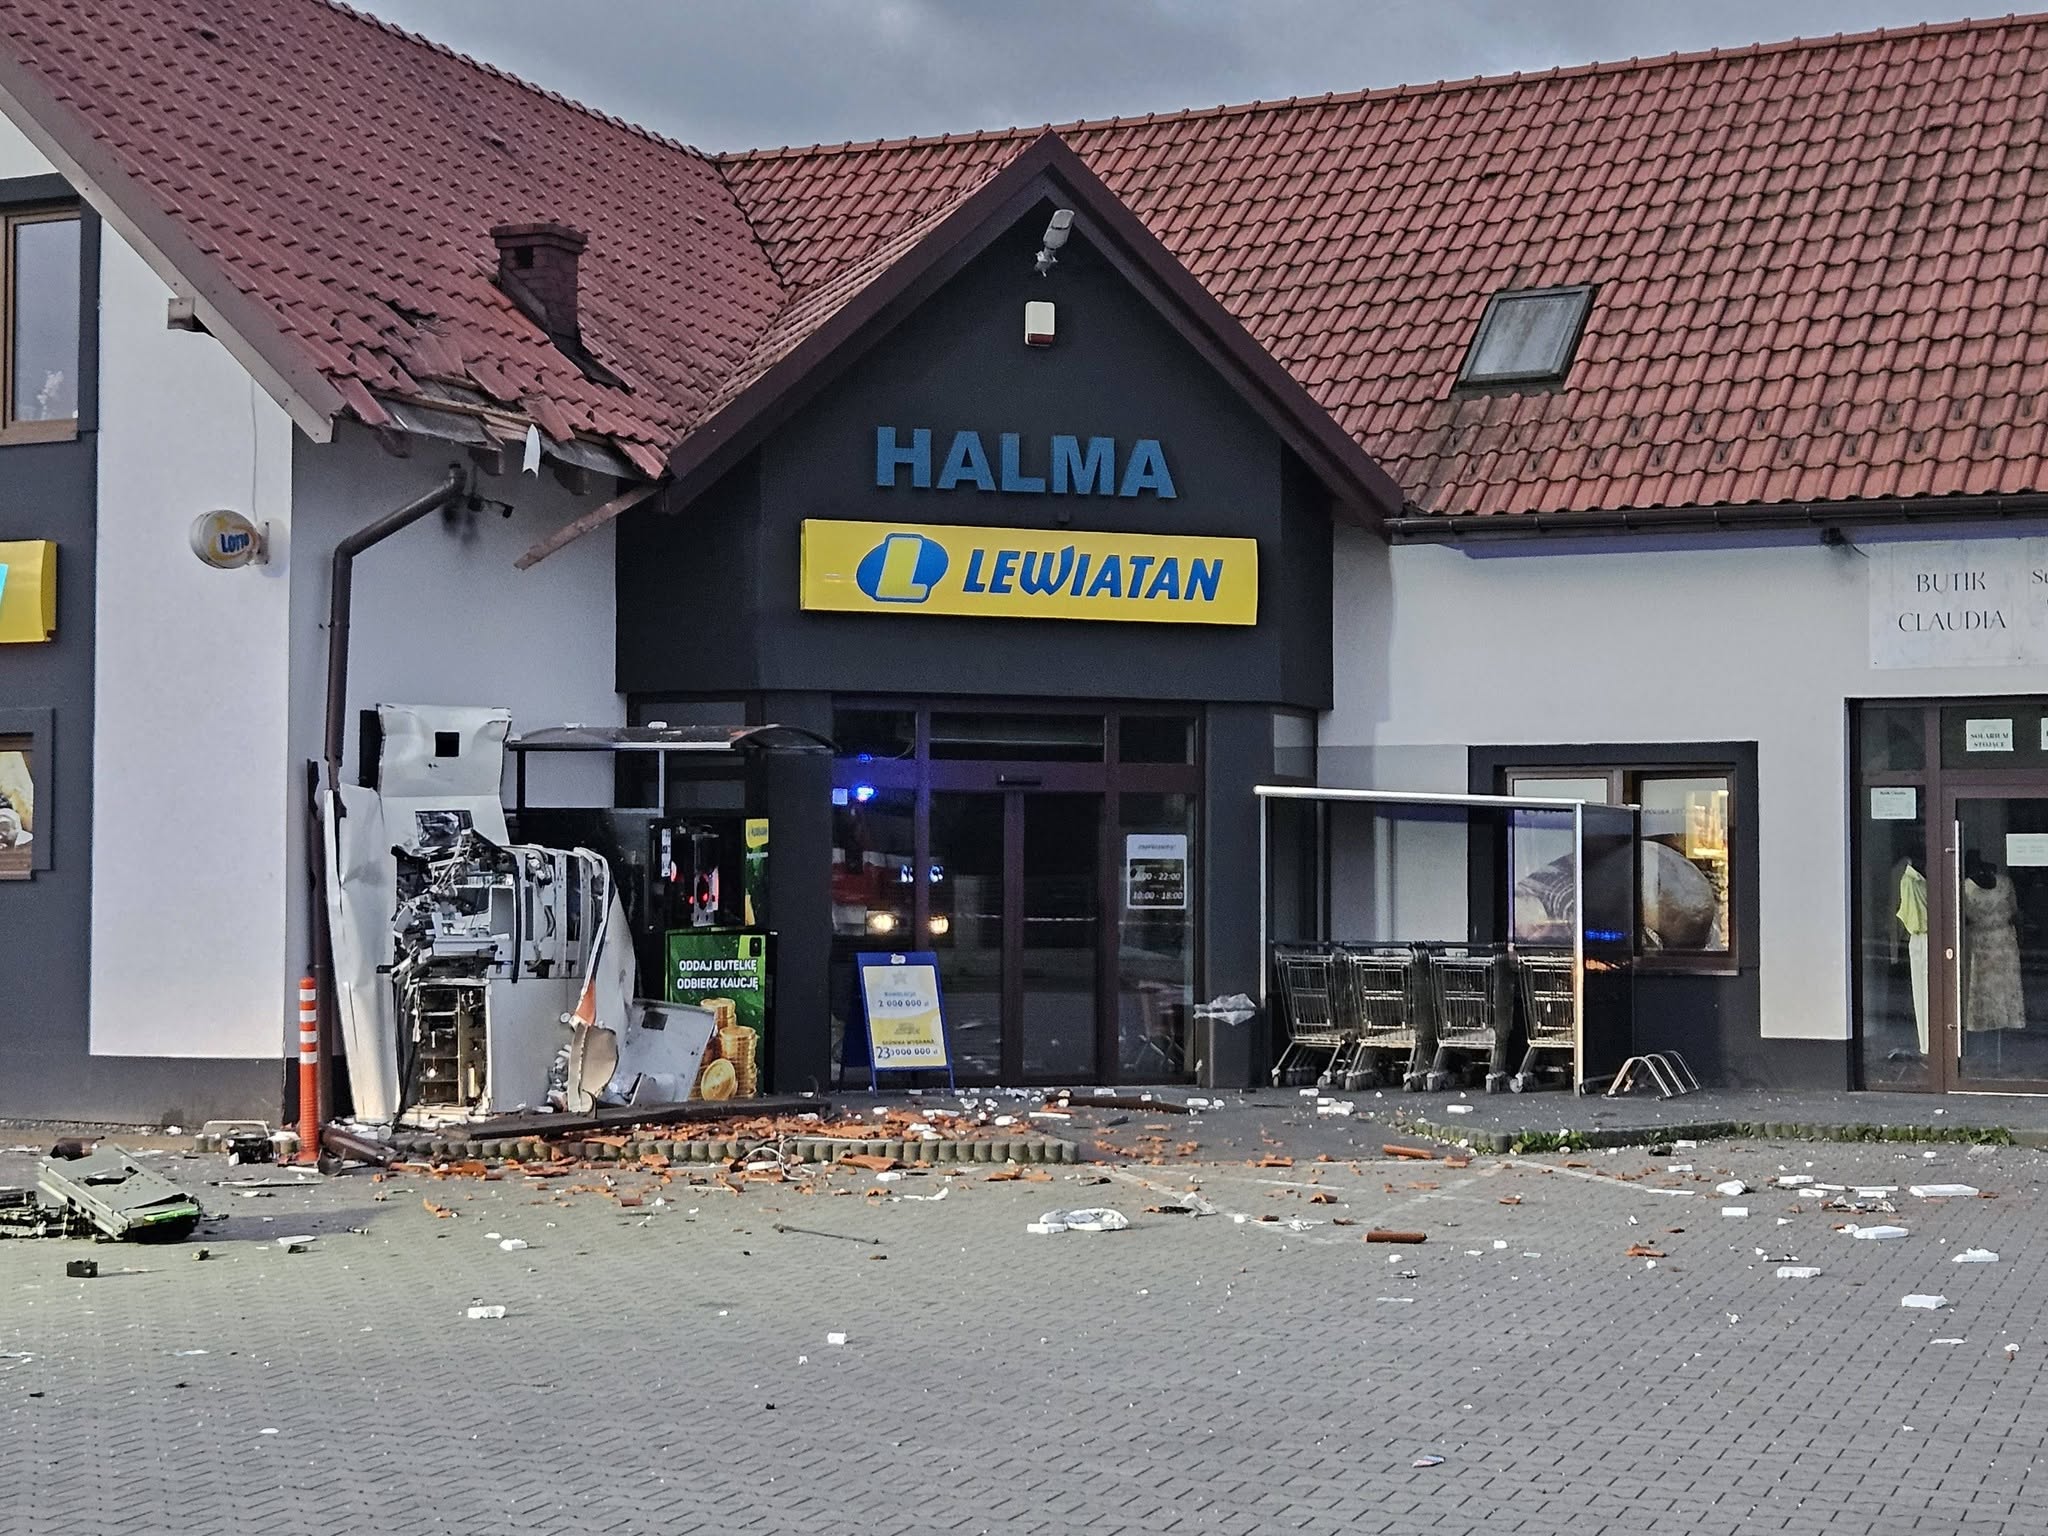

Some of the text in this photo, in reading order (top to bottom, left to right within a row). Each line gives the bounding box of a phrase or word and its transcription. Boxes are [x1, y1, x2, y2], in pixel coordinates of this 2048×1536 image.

[876, 426, 1177, 498] HALMA
[963, 545, 1223, 601] LEWIATAN
[1917, 571, 1986, 594] BUTIK
[1898, 610, 2006, 632] CLAUDIA
[1158, 872, 1180, 881] 22:00
[679, 960, 757, 973] ODDAJ BUTELKĘ
[677, 977, 759, 990] ODBIERZ KAUCJĘ
